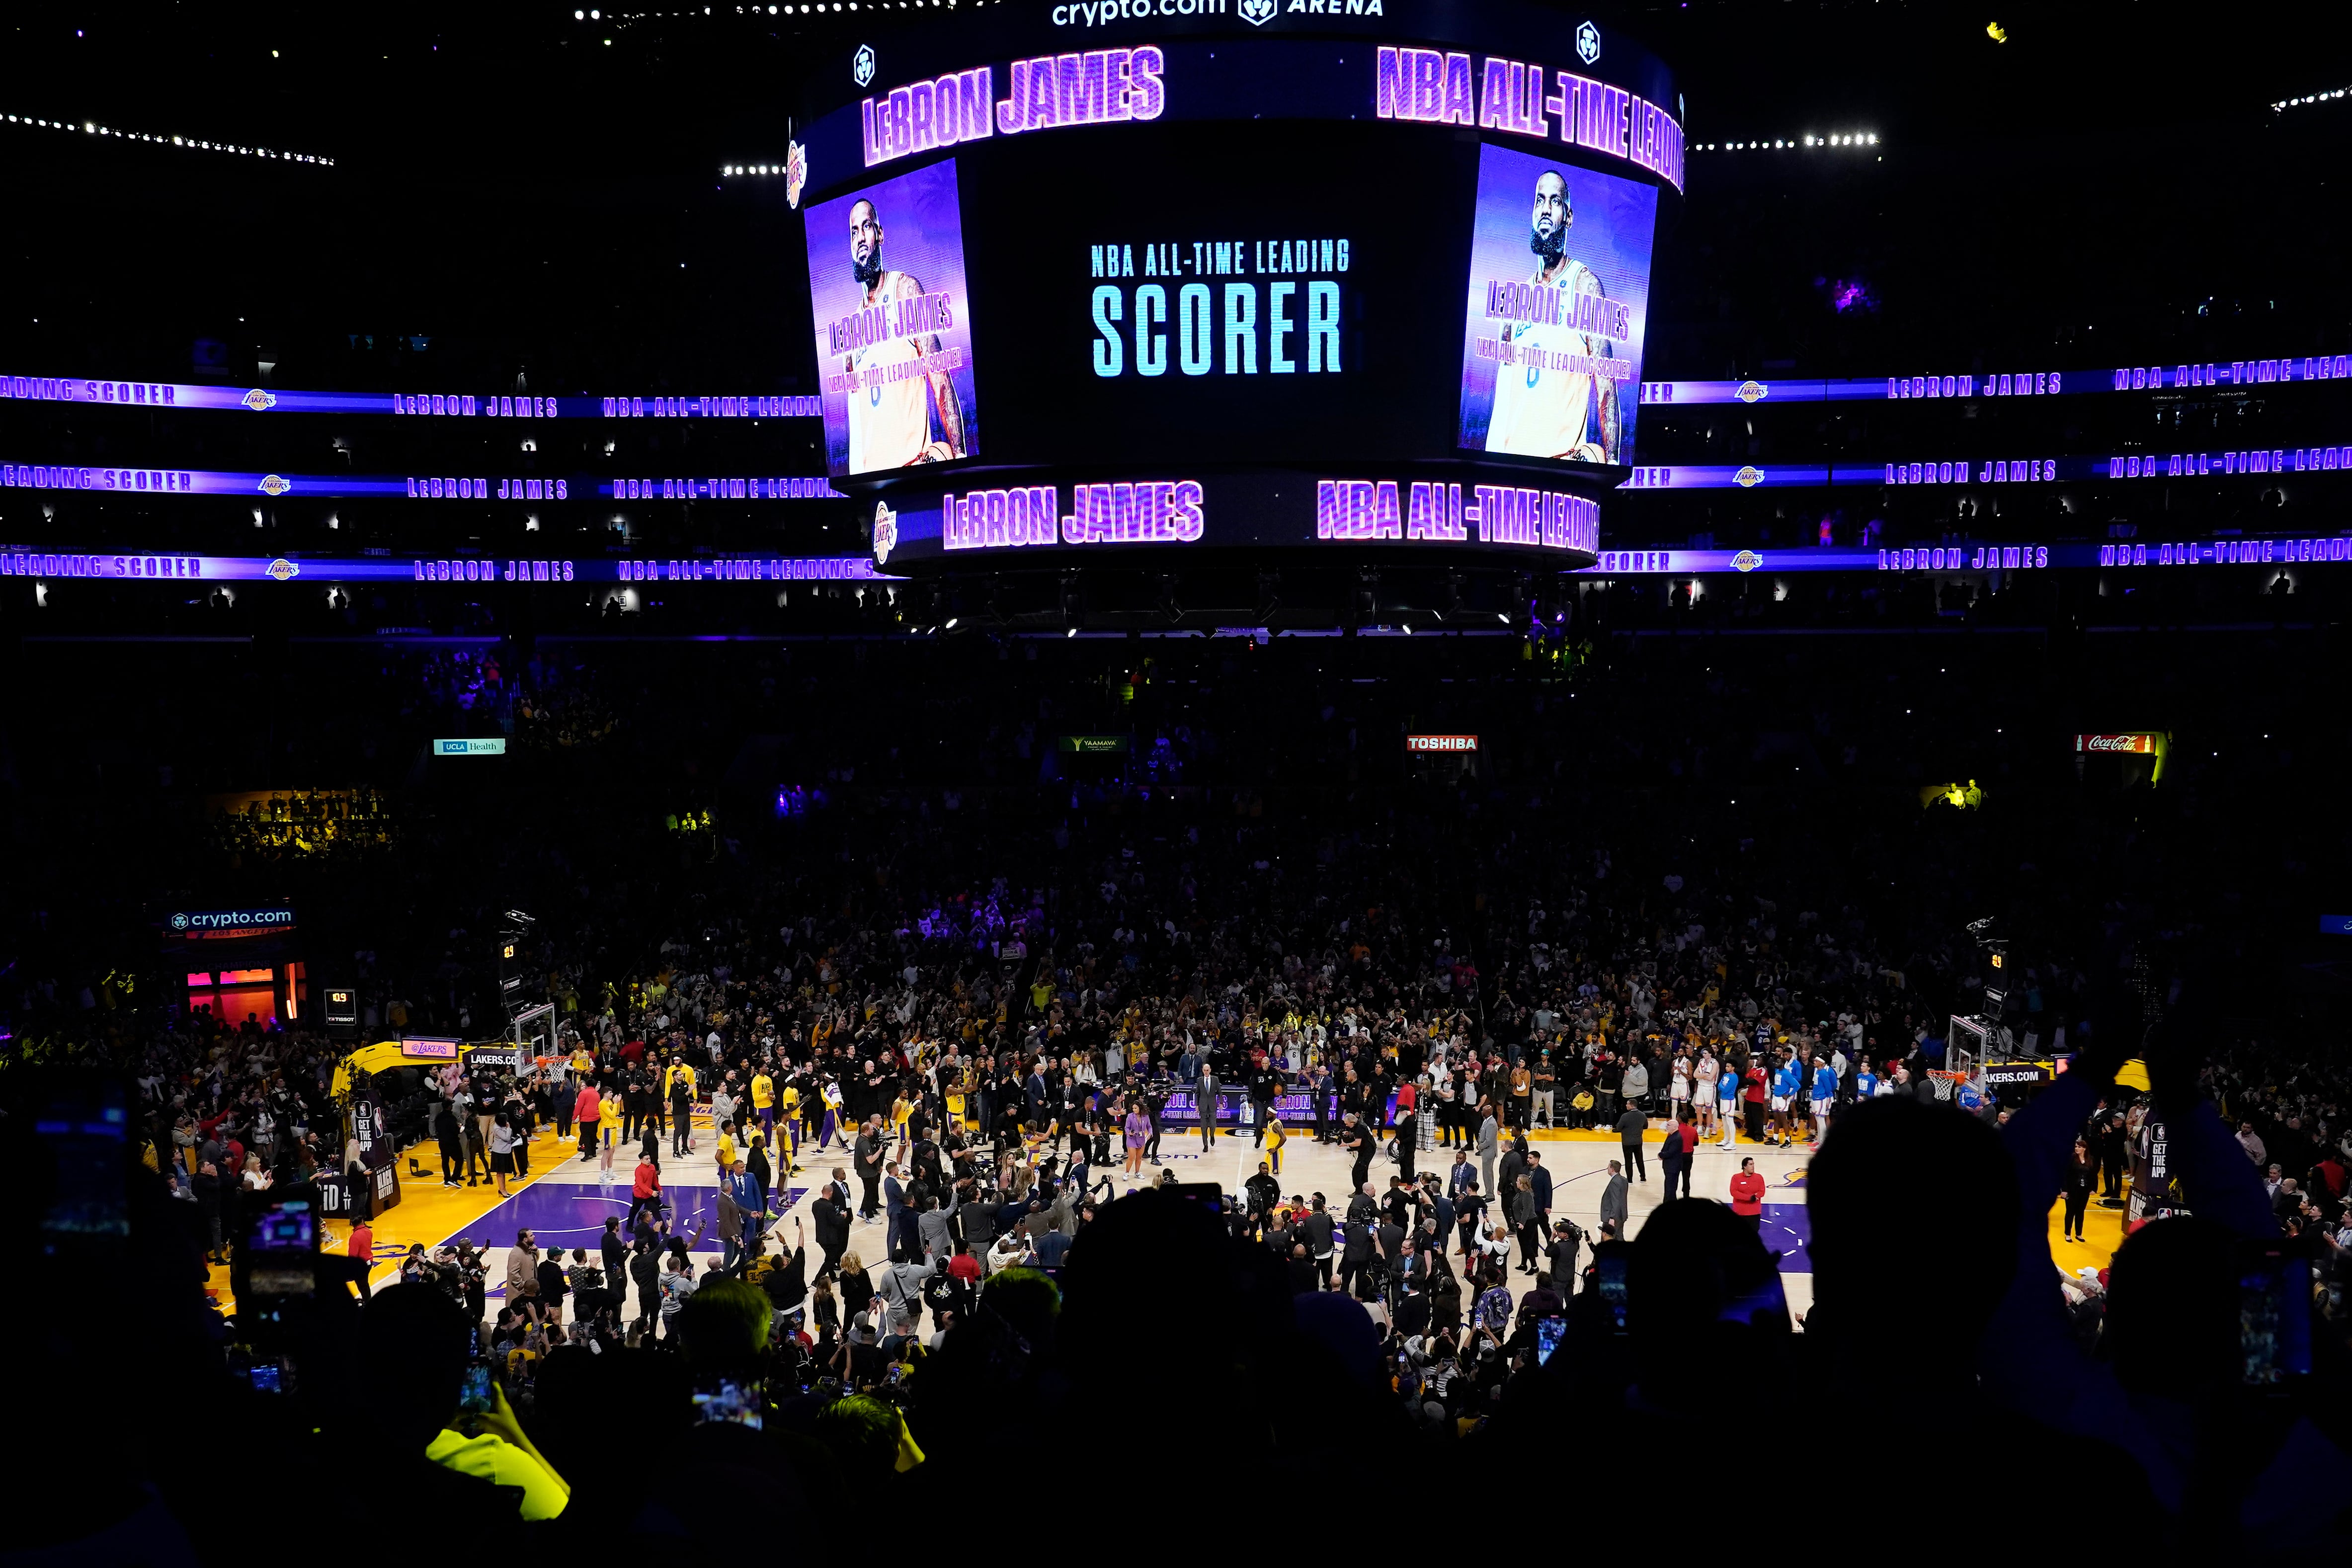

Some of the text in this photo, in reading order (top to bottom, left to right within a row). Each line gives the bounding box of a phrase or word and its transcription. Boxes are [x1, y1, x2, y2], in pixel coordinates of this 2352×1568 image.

[1052, 0, 1226, 26] crypto.com
[997, 46, 1164, 135] JAMES
[1378, 46, 1474, 126] NBA
[1479, 57, 1629, 159] ALL-TIME
[1091, 239, 1349, 277] NBA ALL-TIME LEADING
[893, 291, 954, 341] JAMES
[1566, 291, 1631, 344] JAMES
[1092, 281, 1342, 377] SCORER
[1476, 336, 1631, 381] NBA ALL-TIME LEADING SCORER
[828, 347, 963, 395] NBA ALL-TIME LEADING SCORER
[2115, 355, 2352, 391] NBA ALL-TIME LEA
[85, 380, 175, 405] SCORER
[1983, 373, 2061, 396] JAMES
[486, 396, 558, 417] JAMES
[604, 397, 644, 417] NBA
[654, 397, 748, 416] ALL-TIME
[1980, 460, 2056, 483] JAMES
[2109, 456, 2156, 479] NBA
[2168, 450, 2283, 476] ALL-TIME
[0, 465, 191, 492] EADING SCORER
[497, 479, 568, 499] JAMES
[613, 479, 653, 499] NBA
[663, 479, 758, 499] ALL-TIME
[1061, 480, 1204, 544] JAMES
[1317, 480, 1402, 540] NBA
[1407, 481, 1541, 546] ALL-TIME
[1, 553, 200, 578] LEADING SCORER
[1972, 546, 2048, 569] JAMES
[2101, 544, 2147, 567] NBA
[2159, 540, 2273, 566] ALL-TIME
[505, 560, 574, 581] JAMES
[619, 561, 658, 580] NBA
[669, 560, 761, 580] ALL-TIME
[771, 559, 853, 580] LEADING
[1408, 737, 1477, 749] TOSHIBA
[191, 910, 292, 927] crypto.com
[358, 1119, 370, 1130] GET
[359, 1130, 372, 1141] THE
[359, 1141, 372, 1152] APP
[2153, 1144, 2167, 1155] GET
[2151, 1167, 2166, 1178] APP
[2152, 1155, 2166, 1166] THE
